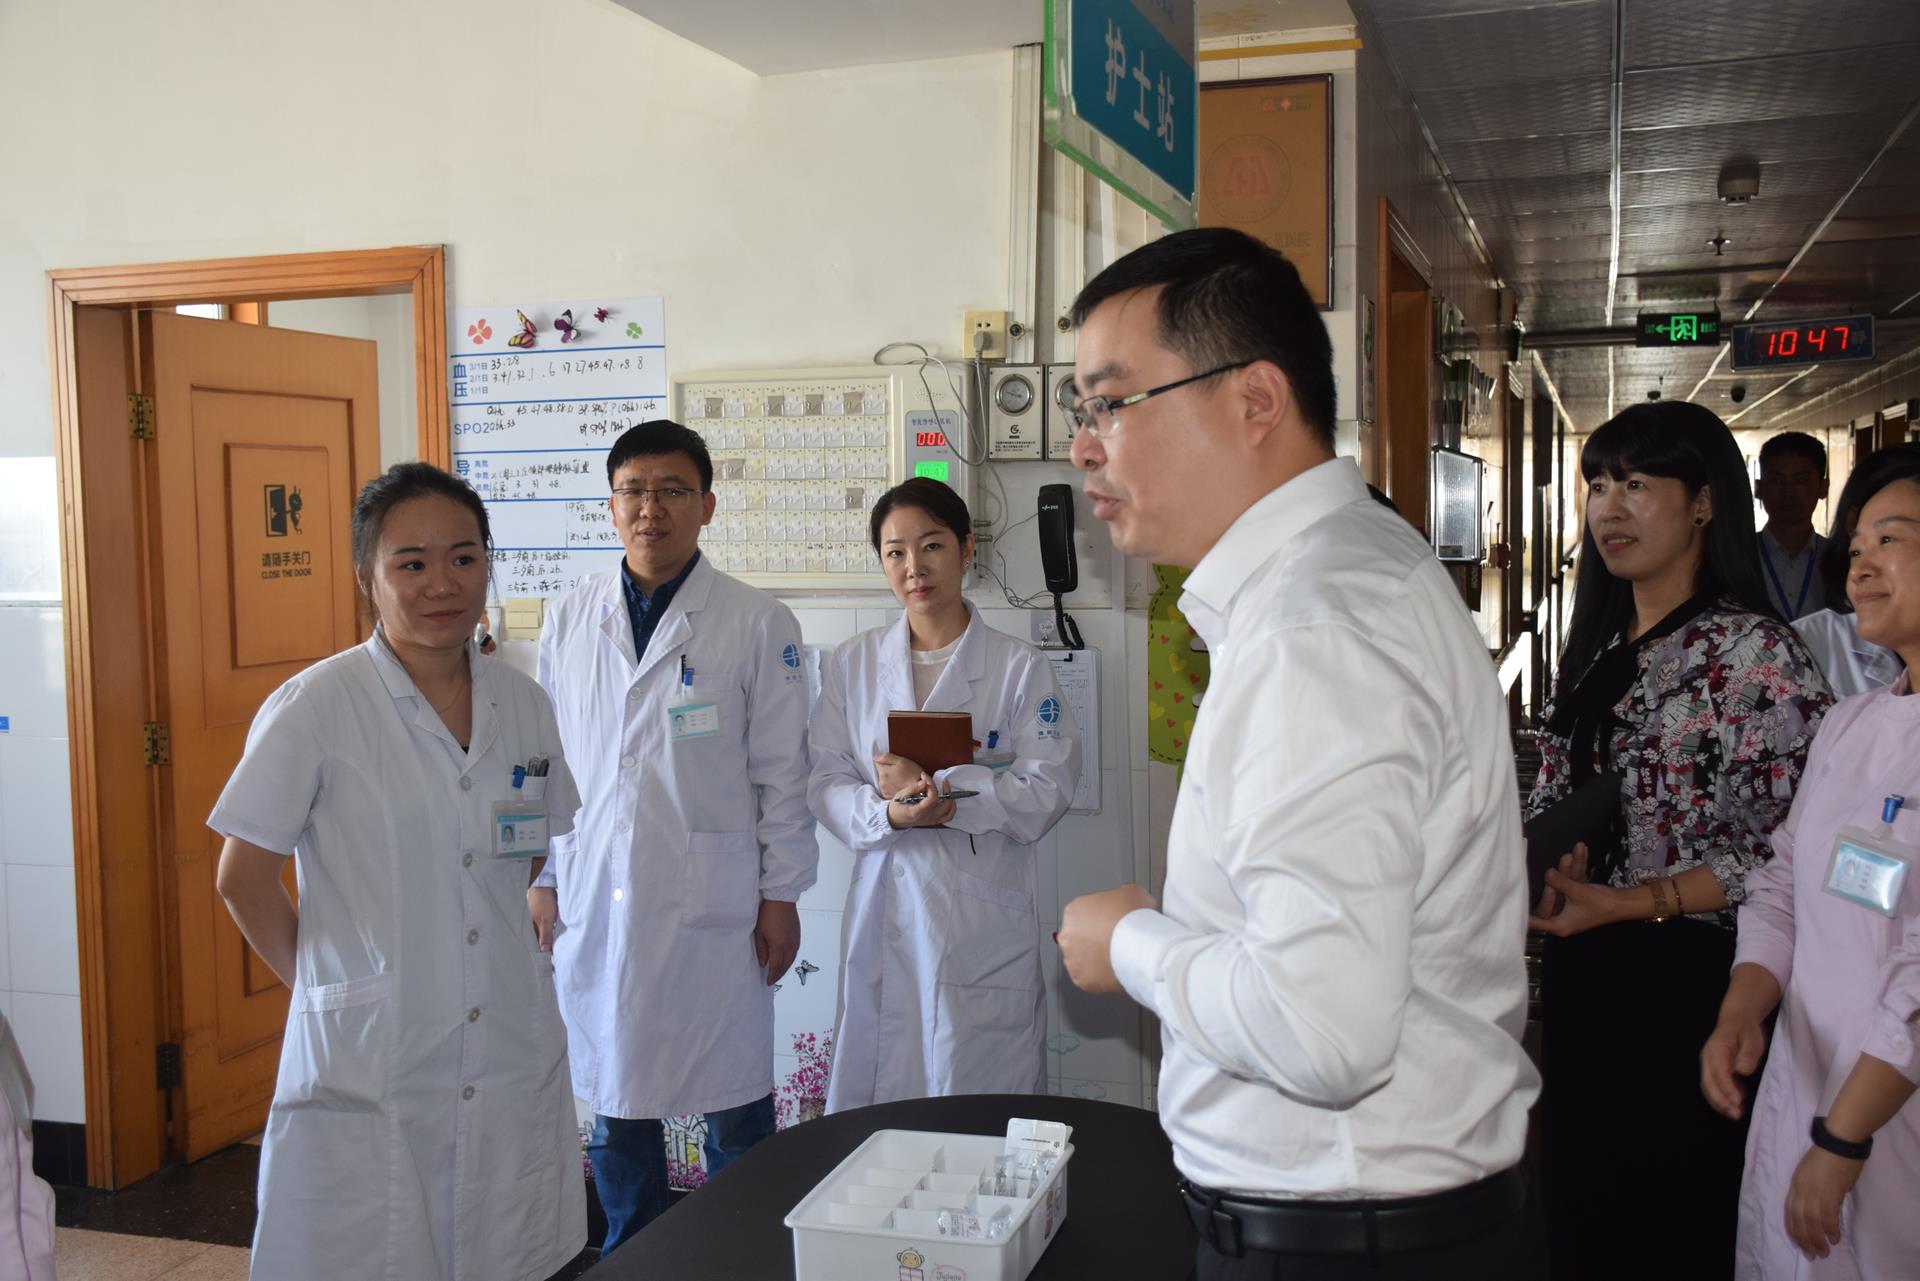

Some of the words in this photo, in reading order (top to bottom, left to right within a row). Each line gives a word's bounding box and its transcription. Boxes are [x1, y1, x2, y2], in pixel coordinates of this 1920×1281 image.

[1104, 16, 1174, 153] 护士站
[1768, 329, 1798, 356] 10
[1807, 326, 1849, 352] 47
[452, 362, 468, 397] 血压
[453, 422, 490, 435] SPO2
[261, 550, 311, 567] 请随手关门
[261, 570, 281, 579] CLOSE
[282, 569, 293, 577] THE
[294, 567, 312, 576] DOOR
